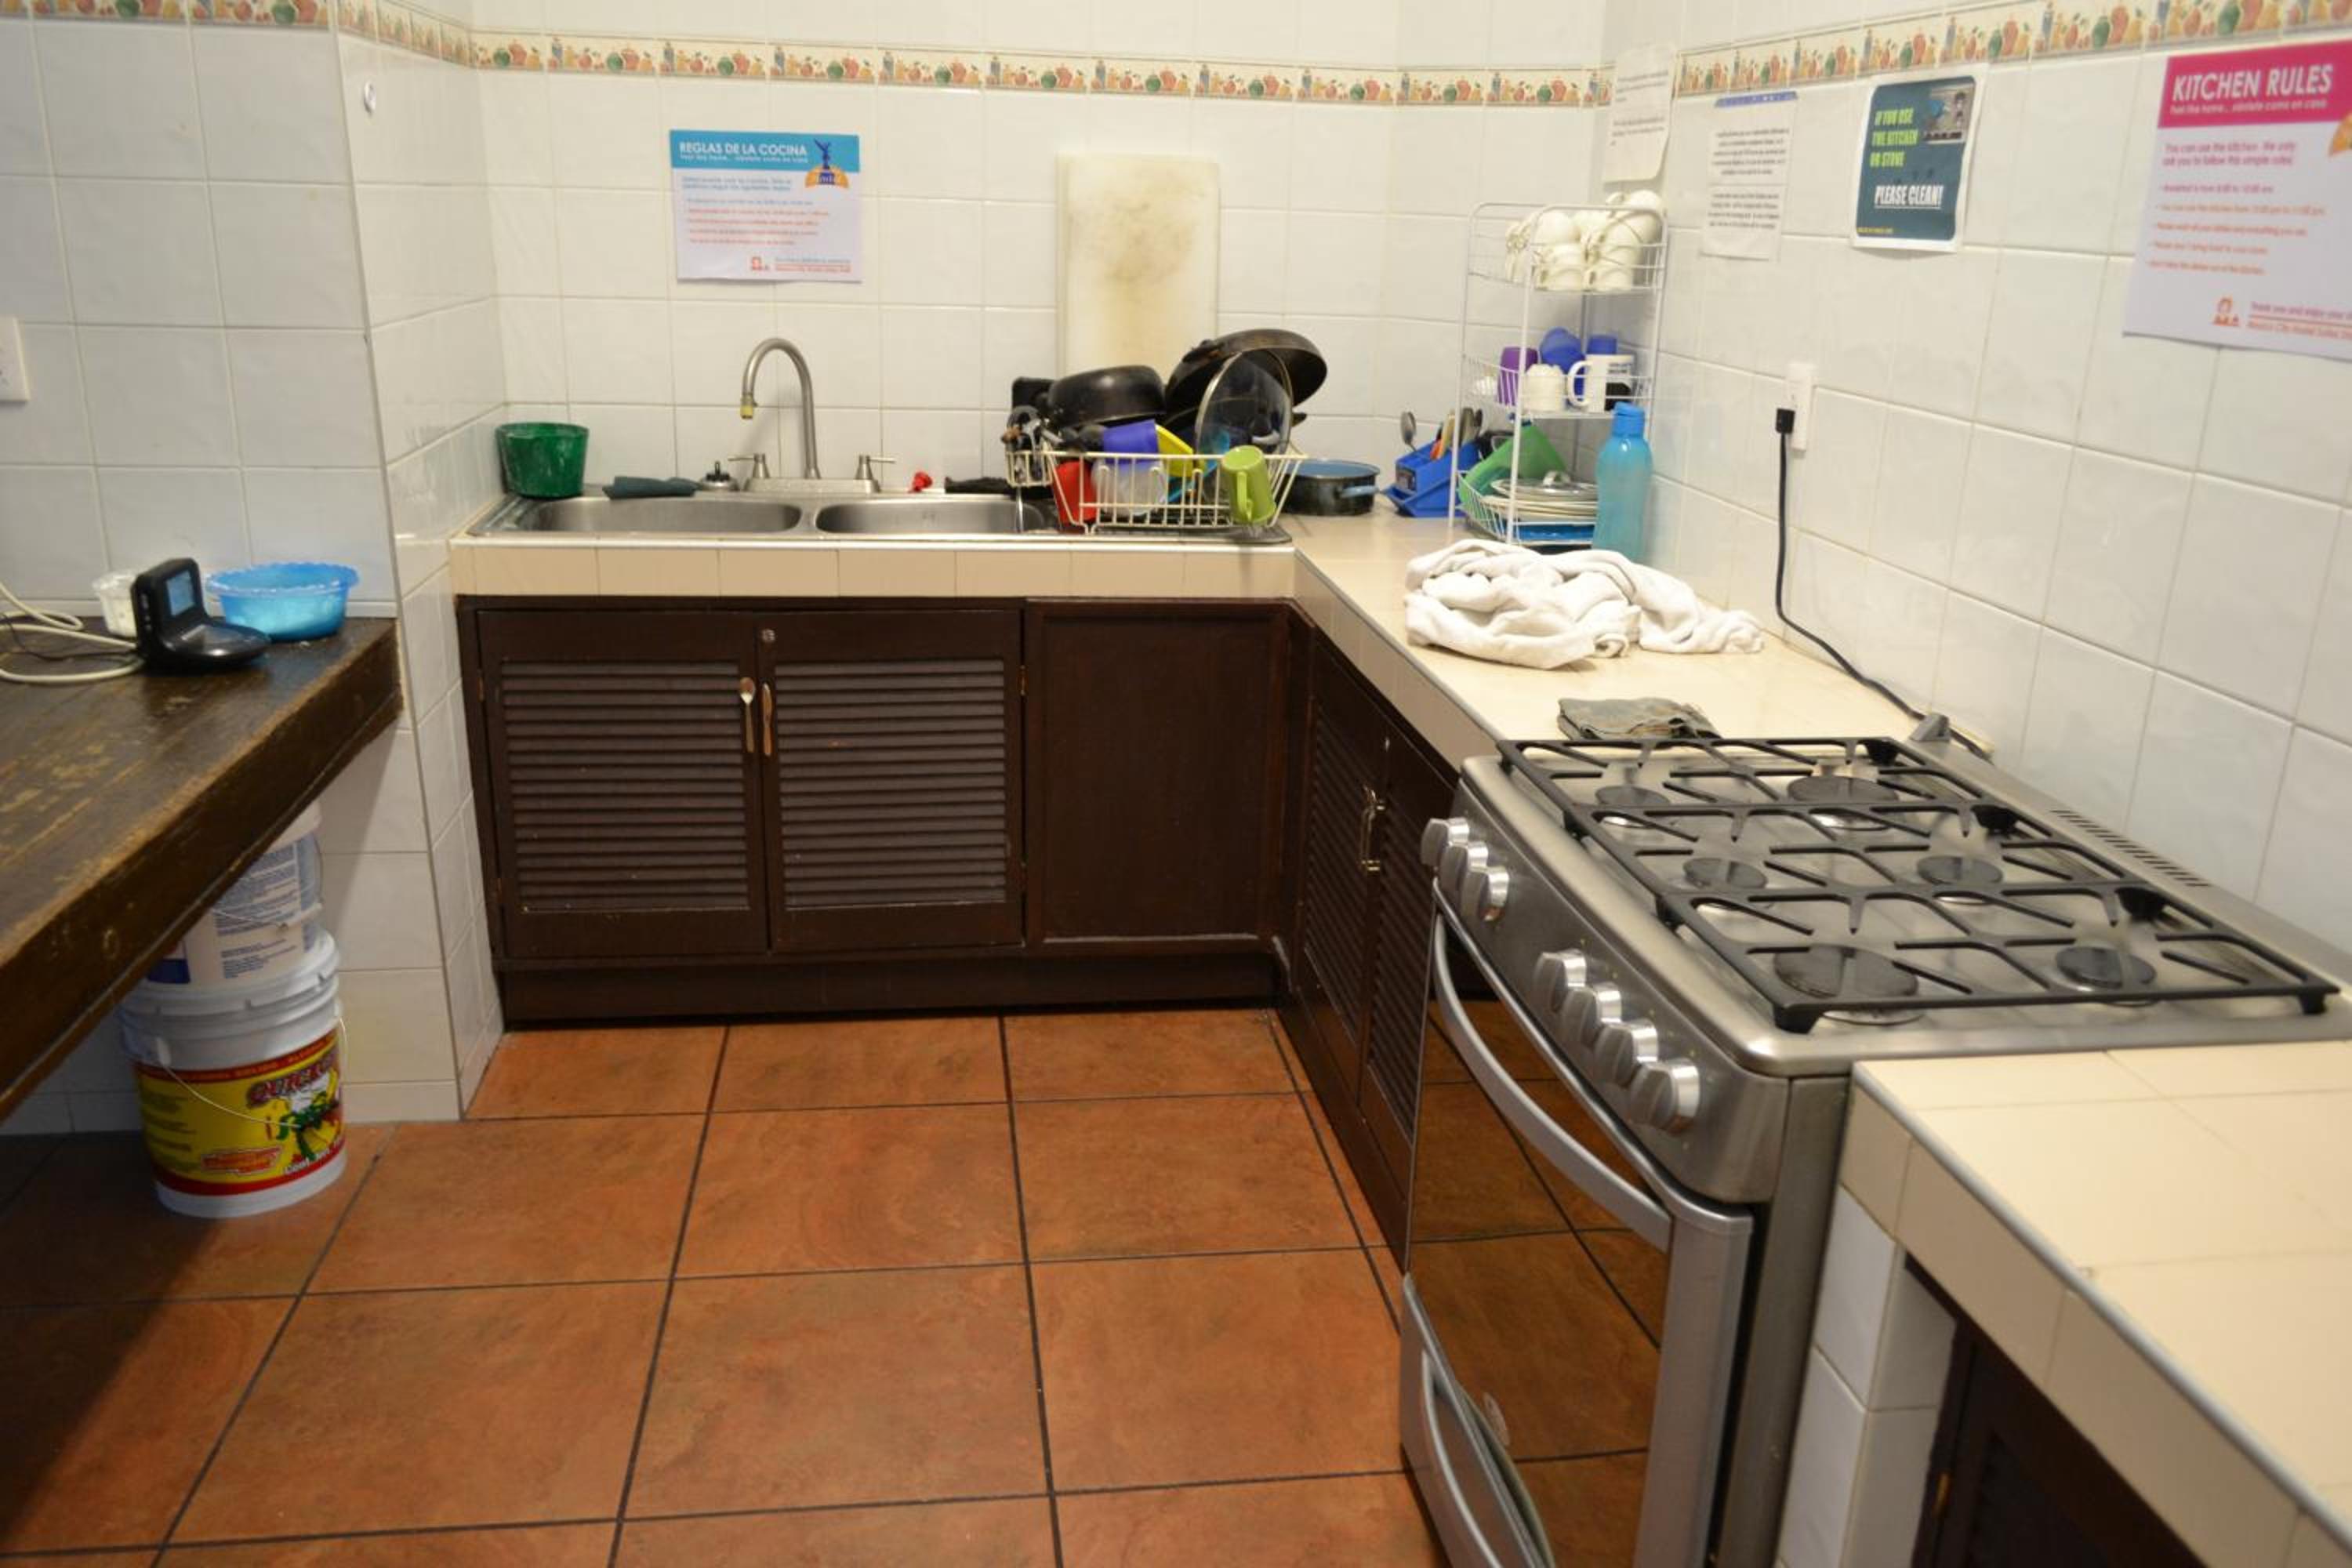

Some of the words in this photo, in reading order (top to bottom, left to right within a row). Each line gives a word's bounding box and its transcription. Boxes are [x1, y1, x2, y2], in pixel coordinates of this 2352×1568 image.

[2172, 70, 2260, 101] KITCHEN
[2266, 64, 2333, 96] RULES
[1887, 129, 1918, 146] KITCHEN
[679, 142, 723, 154] REGLAS
[724, 143, 739, 154] DE
[742, 143, 757, 155] LA
[758, 143, 808, 156] COCINA
[1875, 185, 1907, 205] PLEASE
[1908, 185, 1944, 207] CLEAN!
